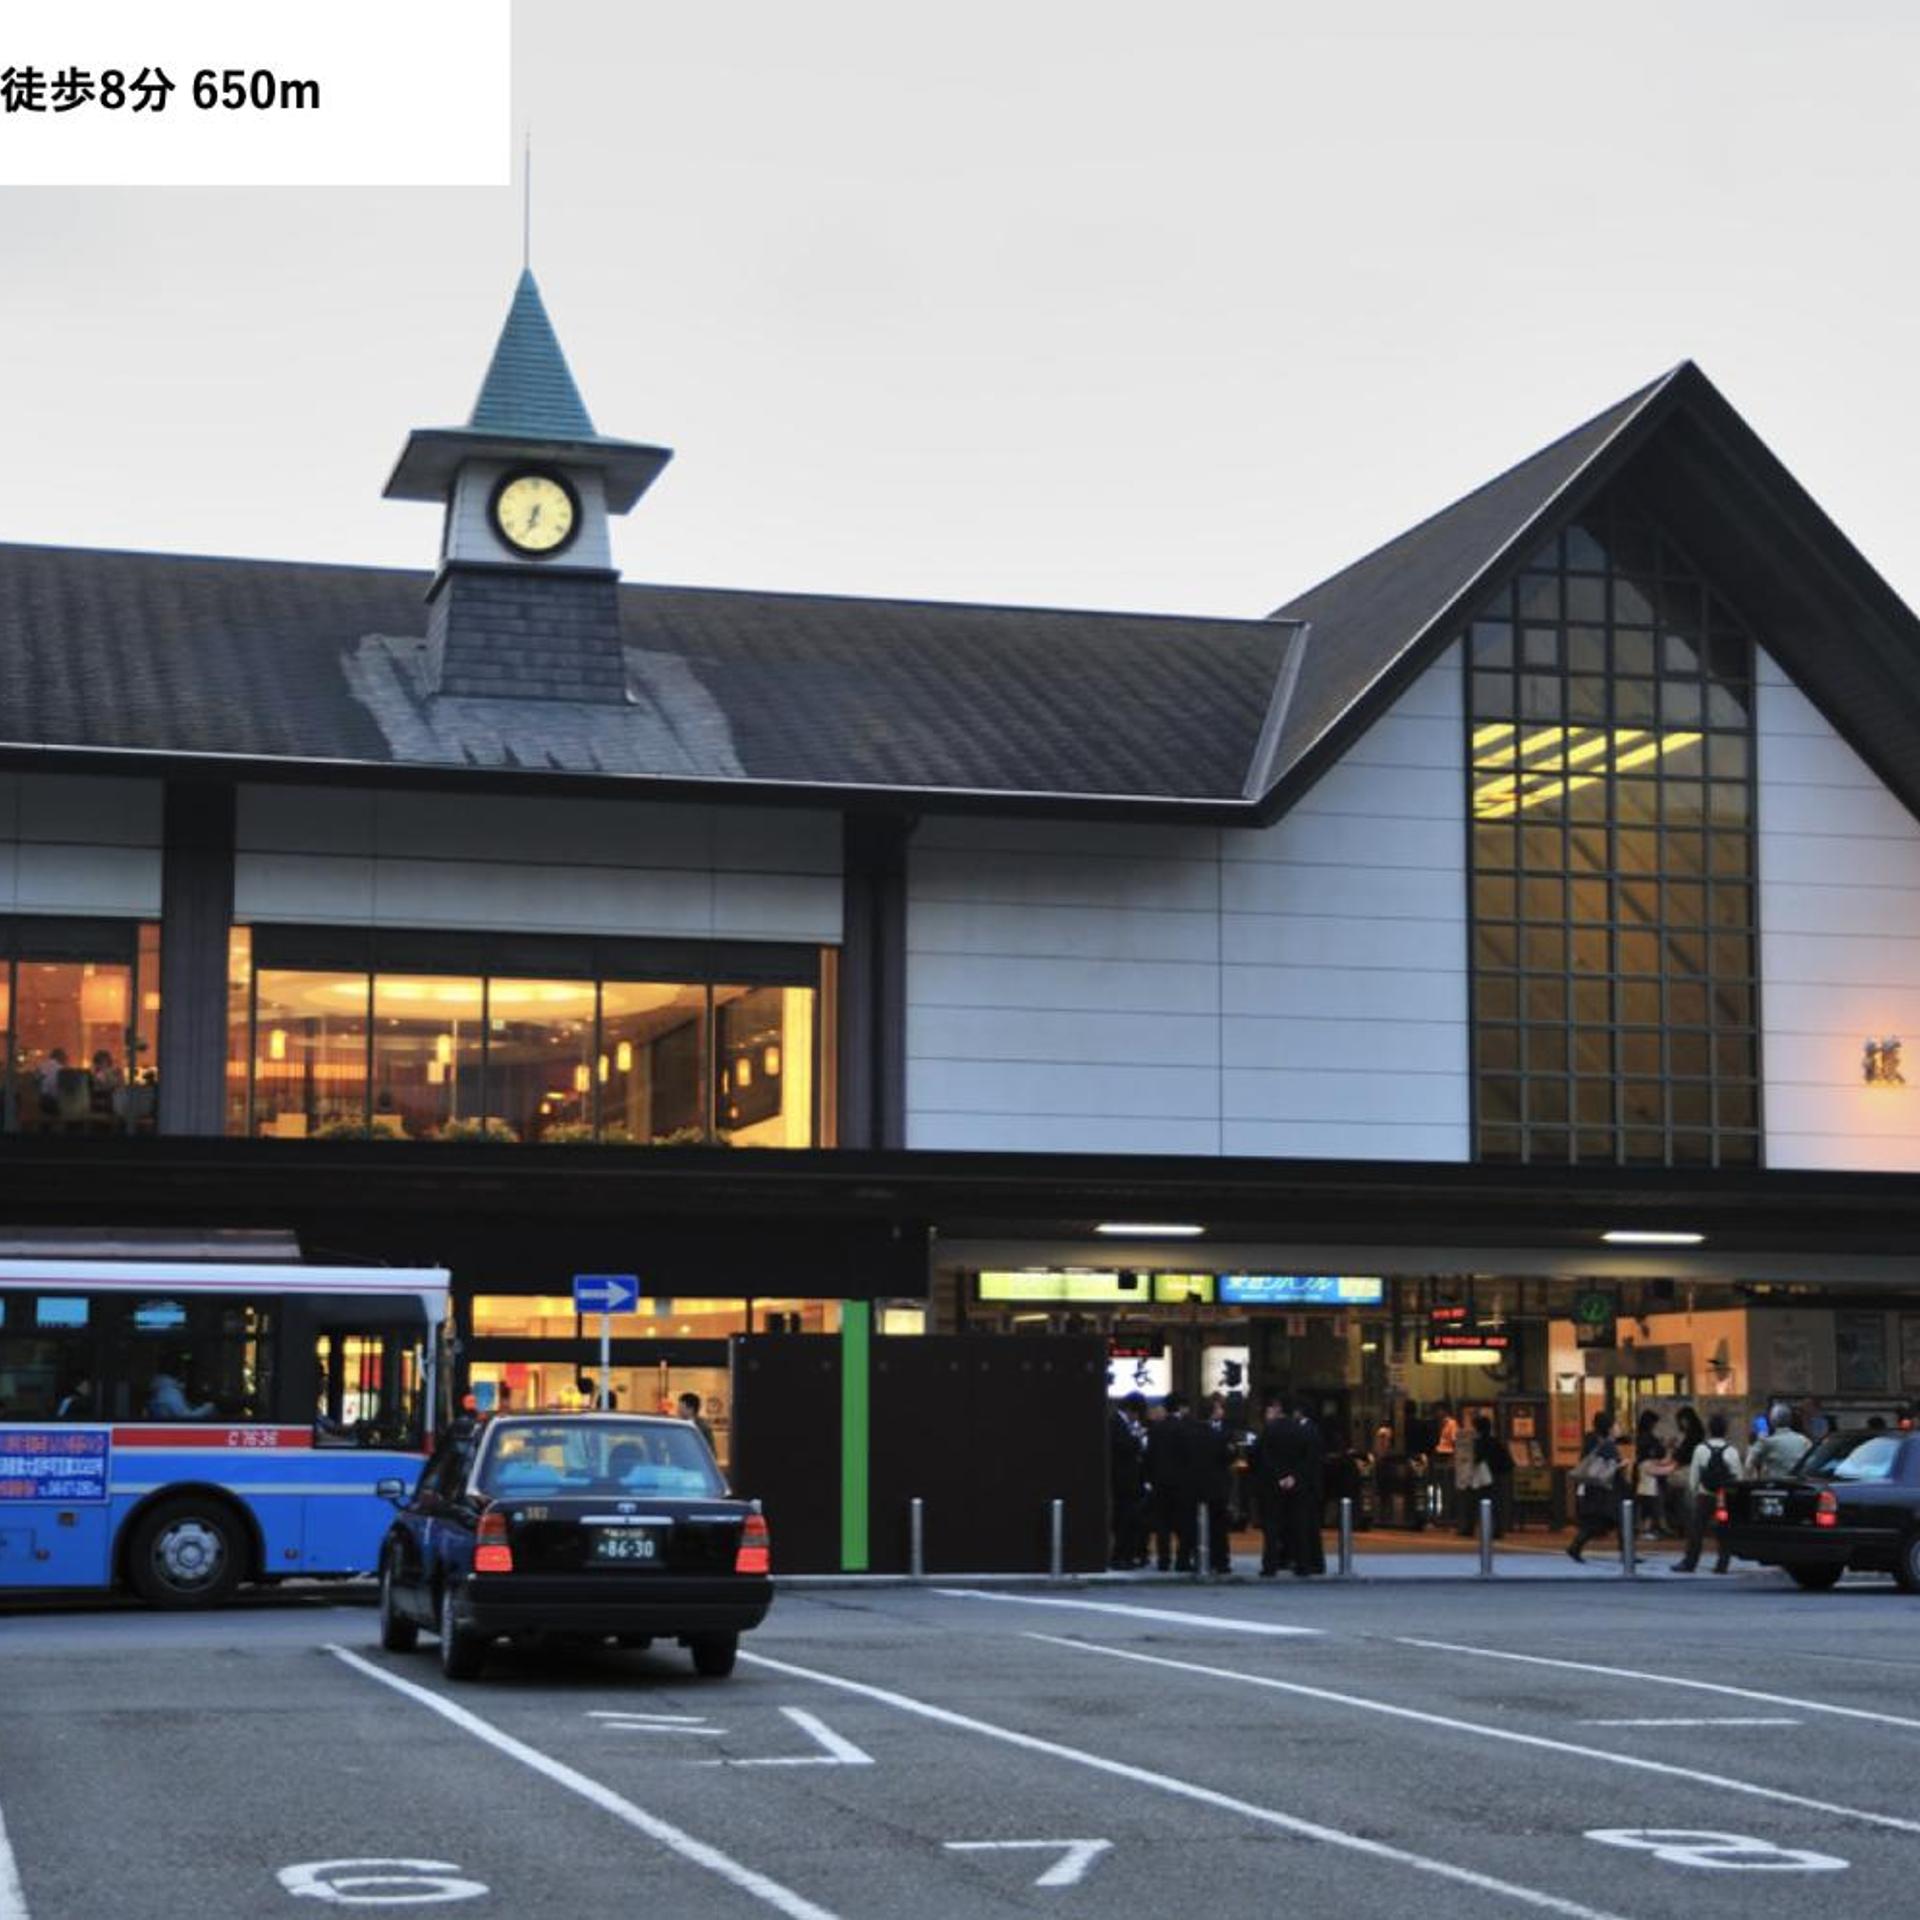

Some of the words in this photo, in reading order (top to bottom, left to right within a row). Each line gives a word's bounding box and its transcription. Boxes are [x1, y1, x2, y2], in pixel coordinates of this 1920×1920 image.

[942, 1838, 1115, 1886] 7
[1582, 1829, 1850, 1870] 8
[275, 1857, 490, 1904] 6
